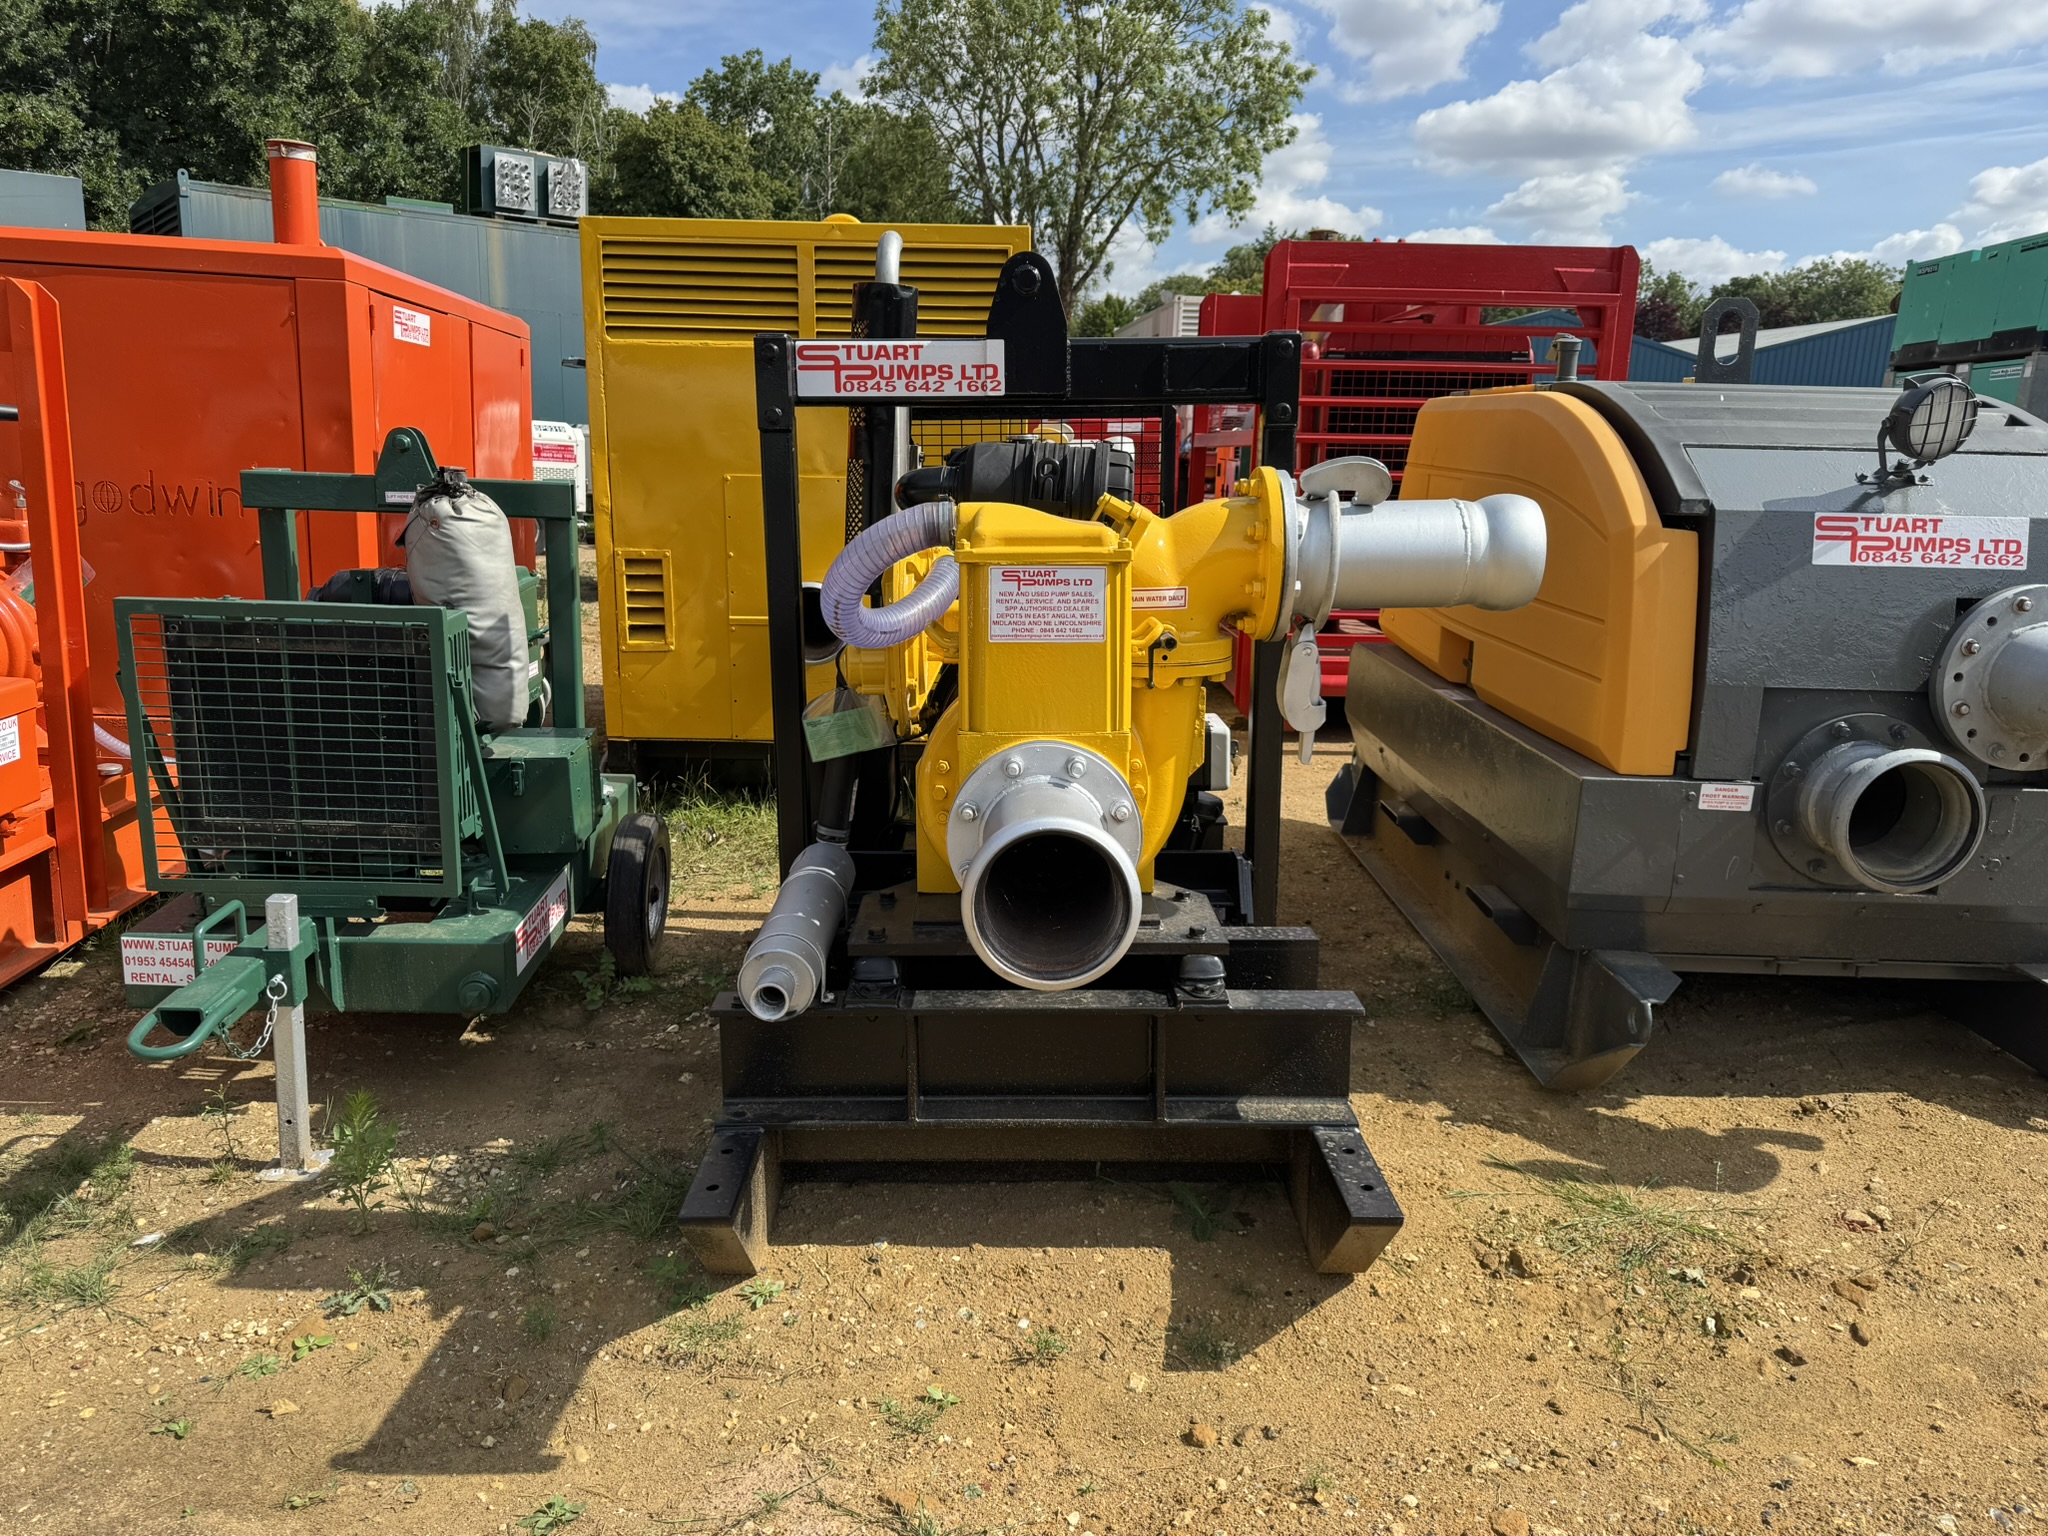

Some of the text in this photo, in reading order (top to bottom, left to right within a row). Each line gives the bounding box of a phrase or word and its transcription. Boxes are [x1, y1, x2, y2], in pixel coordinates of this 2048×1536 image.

[395, 310, 416, 323] STUART
[797, 345, 924, 362] STUART
[798, 364, 999, 384] PUMPS LTD
[842, 380, 1002, 392] 0845 642 1662
[1816, 516, 1943, 534] STUART
[1816, 535, 2022, 554] PUMPS LTD
[1858, 551, 2024, 566] 0845 642 1662
[1002, 570, 1058, 579] STUART
[1002, 578, 1070, 588] PUMPS
[517, 894, 548, 945] STUART
[125, 956, 156, 966] 01953
[159, 957, 195, 968] 454540
[131, 972, 176, 983] RENTAL
